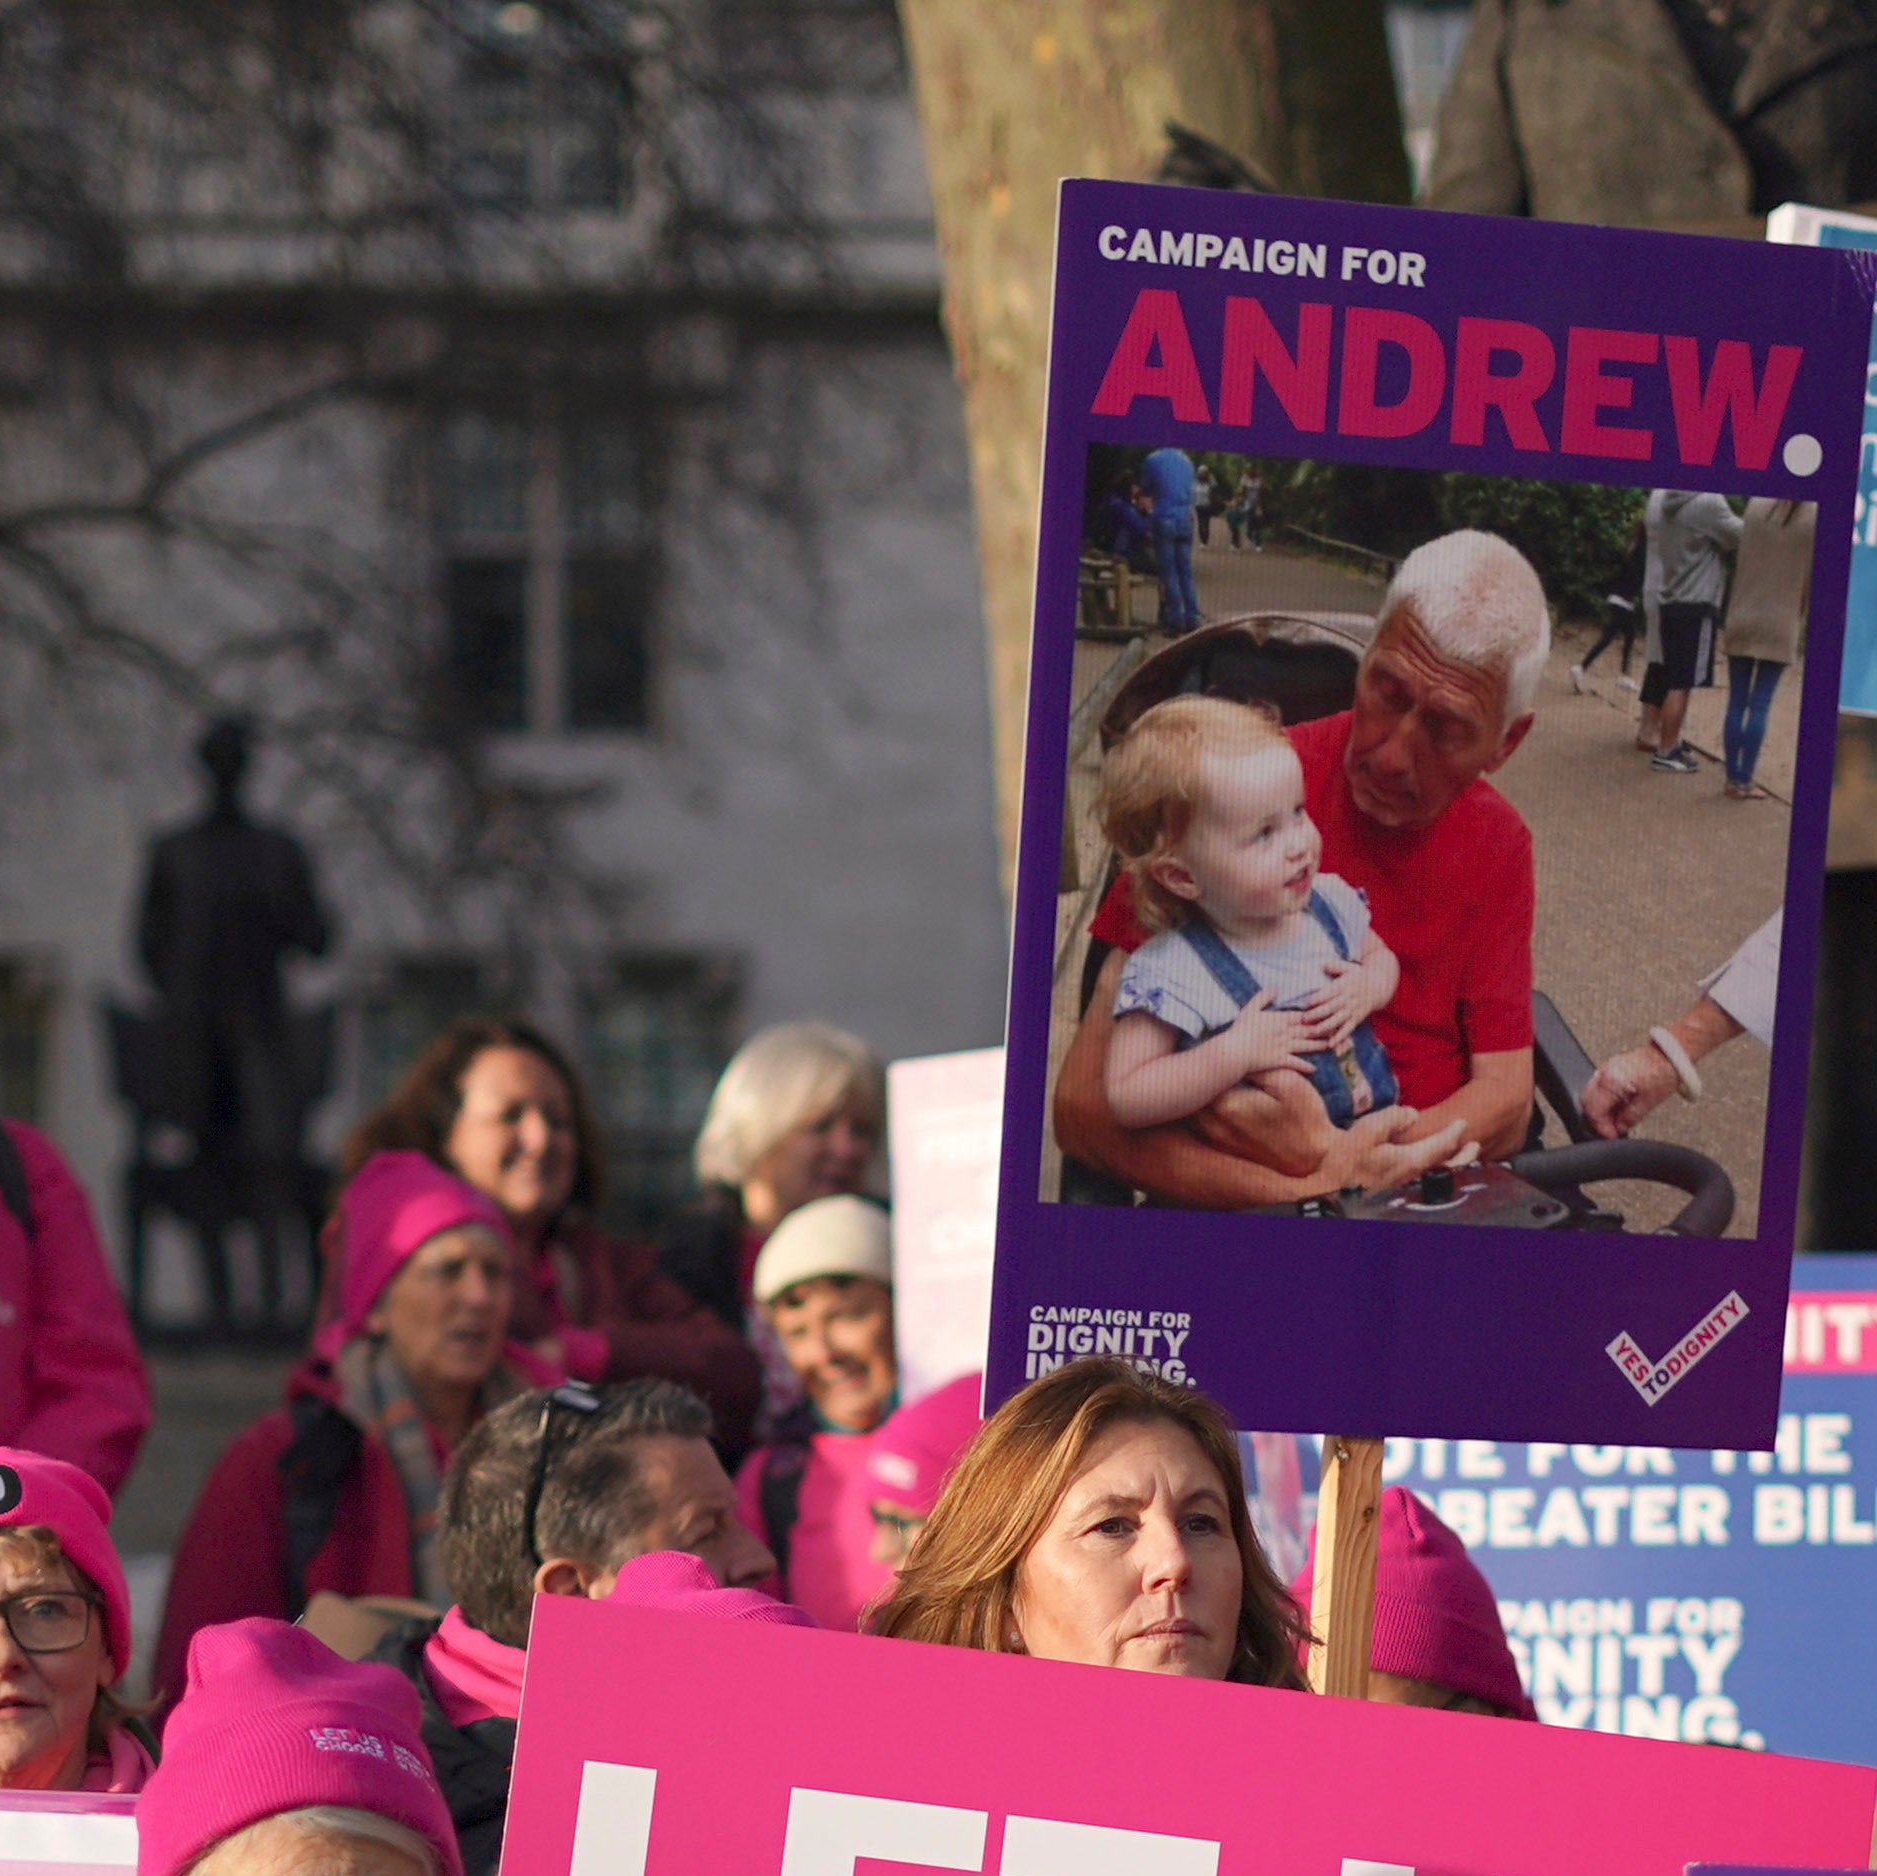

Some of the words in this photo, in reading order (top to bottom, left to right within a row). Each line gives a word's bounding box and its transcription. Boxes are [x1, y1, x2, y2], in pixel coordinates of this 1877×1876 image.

[1097, 225, 1327, 277] CAMPAIGN
[1341, 245, 1427, 288] FOR
[1090, 288, 1822, 477] ANDREW.
[1030, 1305, 1142, 1327] CAMPAIGN
[1149, 1311, 1191, 1329] FOR
[1027, 1323, 1189, 1357] DIGNITY
[1615, 1339, 1650, 1382] YES
[1497, 1598, 1633, 1637] PAIGN
[1647, 1597, 1743, 1636] FOR
[309, 1727, 349, 1741] LET
[356, 1733, 383, 1750] US
